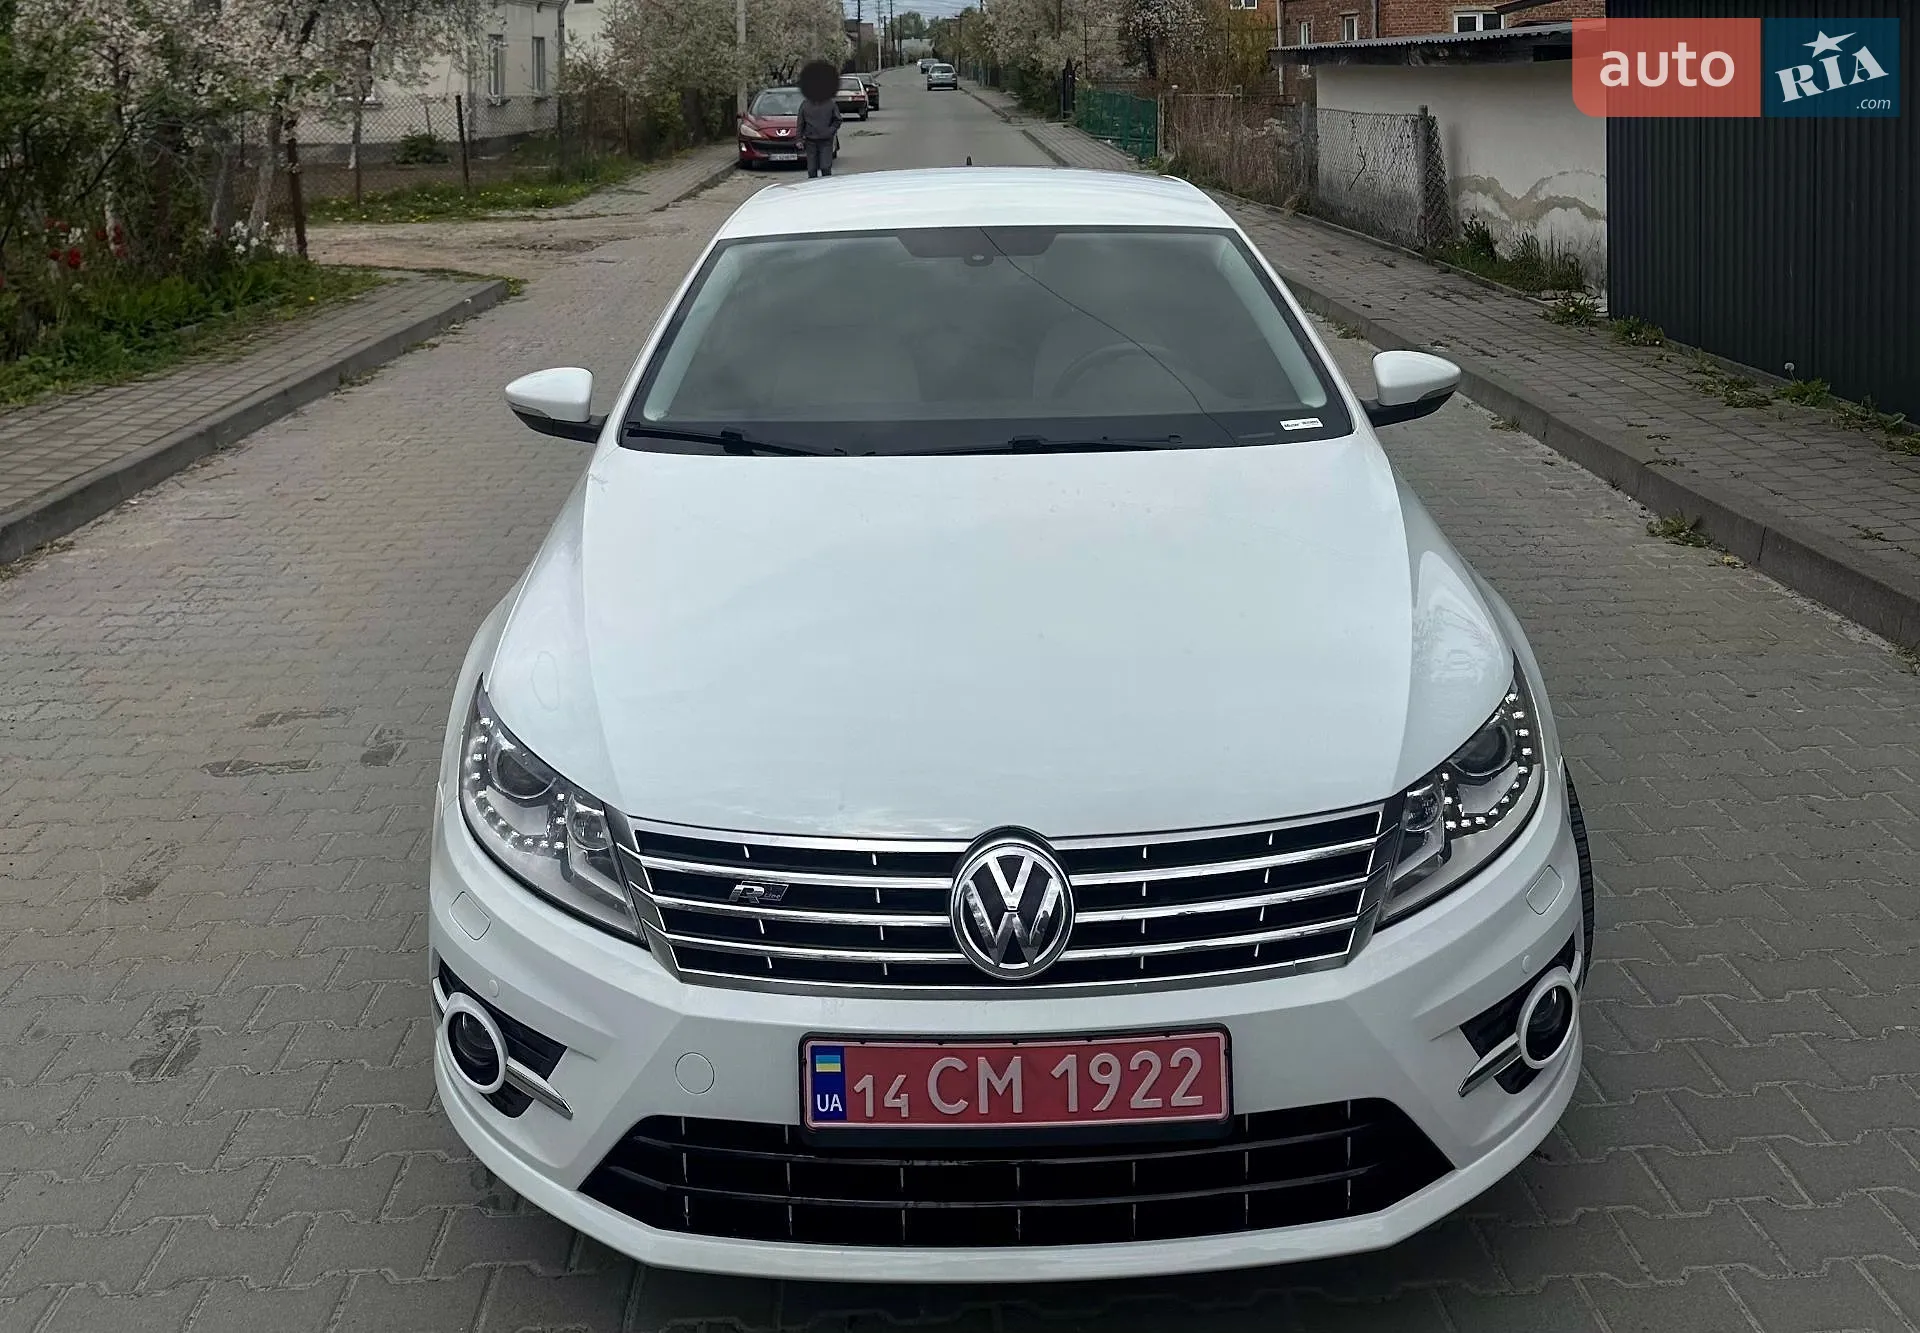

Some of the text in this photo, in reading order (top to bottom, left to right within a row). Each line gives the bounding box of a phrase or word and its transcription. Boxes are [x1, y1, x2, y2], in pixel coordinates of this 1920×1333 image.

[816, 1094, 843, 1113] UA
[853, 1047, 1204, 1118] 14 CM 1922
